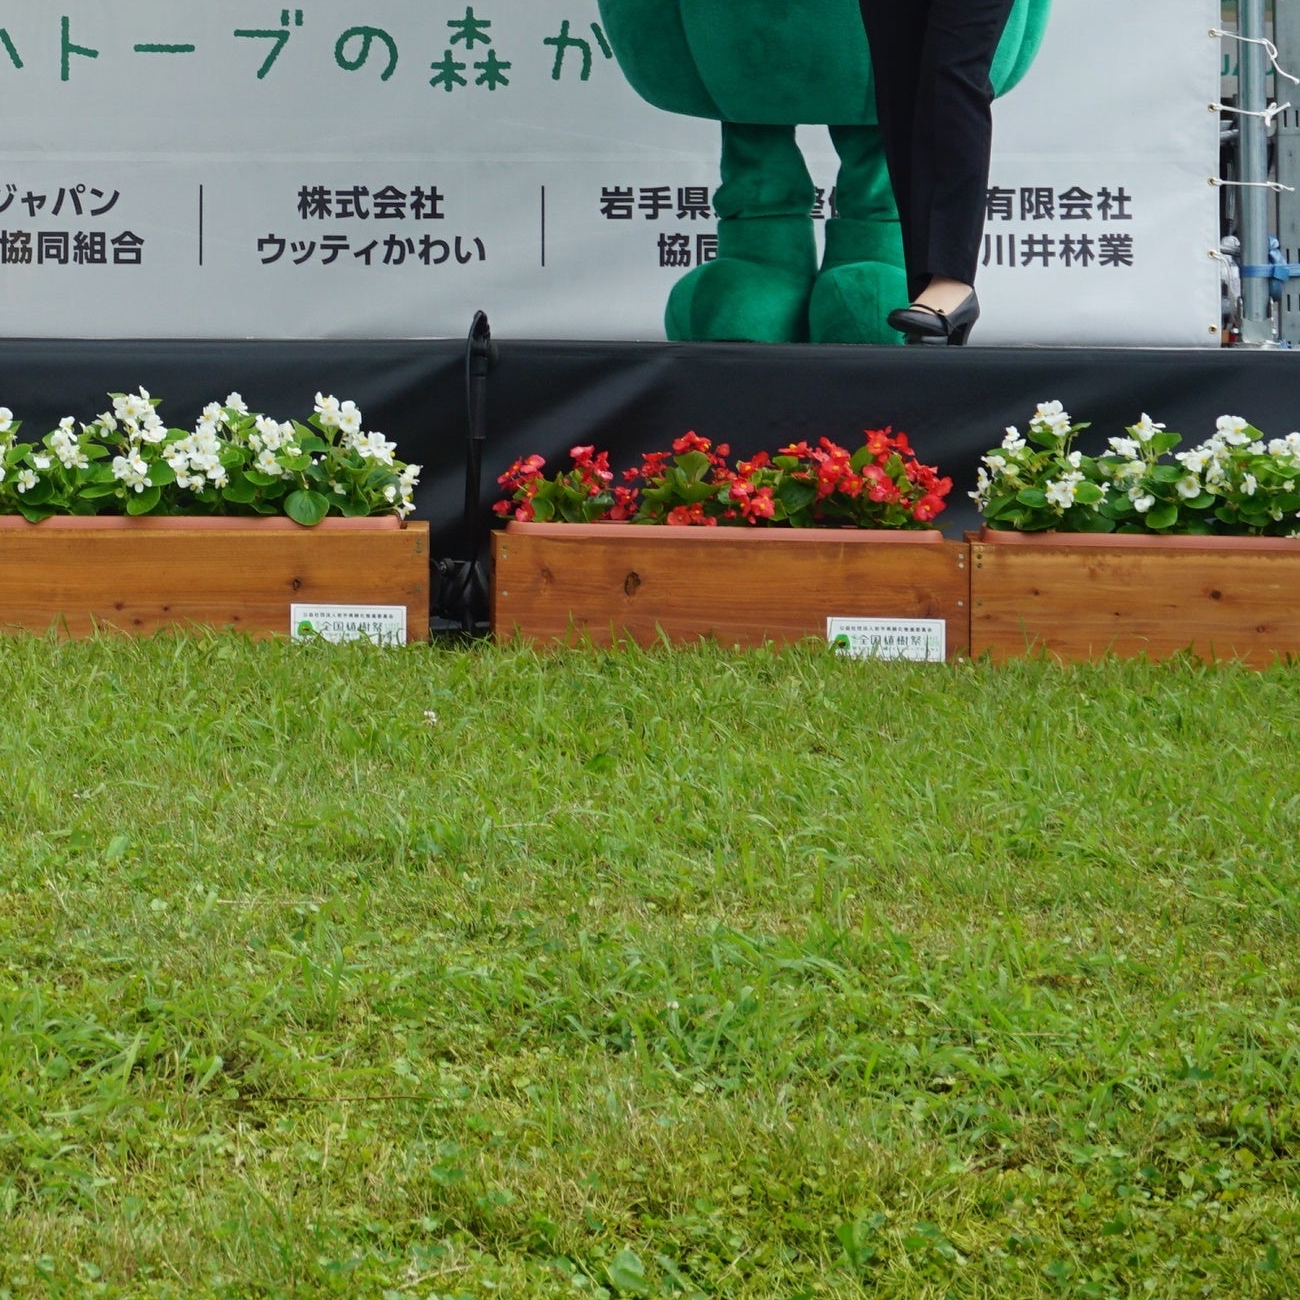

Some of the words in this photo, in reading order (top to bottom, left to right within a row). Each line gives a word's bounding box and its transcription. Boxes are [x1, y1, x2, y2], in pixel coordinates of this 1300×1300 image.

[297, 185, 445, 220] 株式会社
[600, 186, 719, 221] 岩手県
[985, 186, 1133, 221] 有限会社
[257, 233, 487, 266] ウッティかわい
[982, 233, 1134, 267] 川井林業
